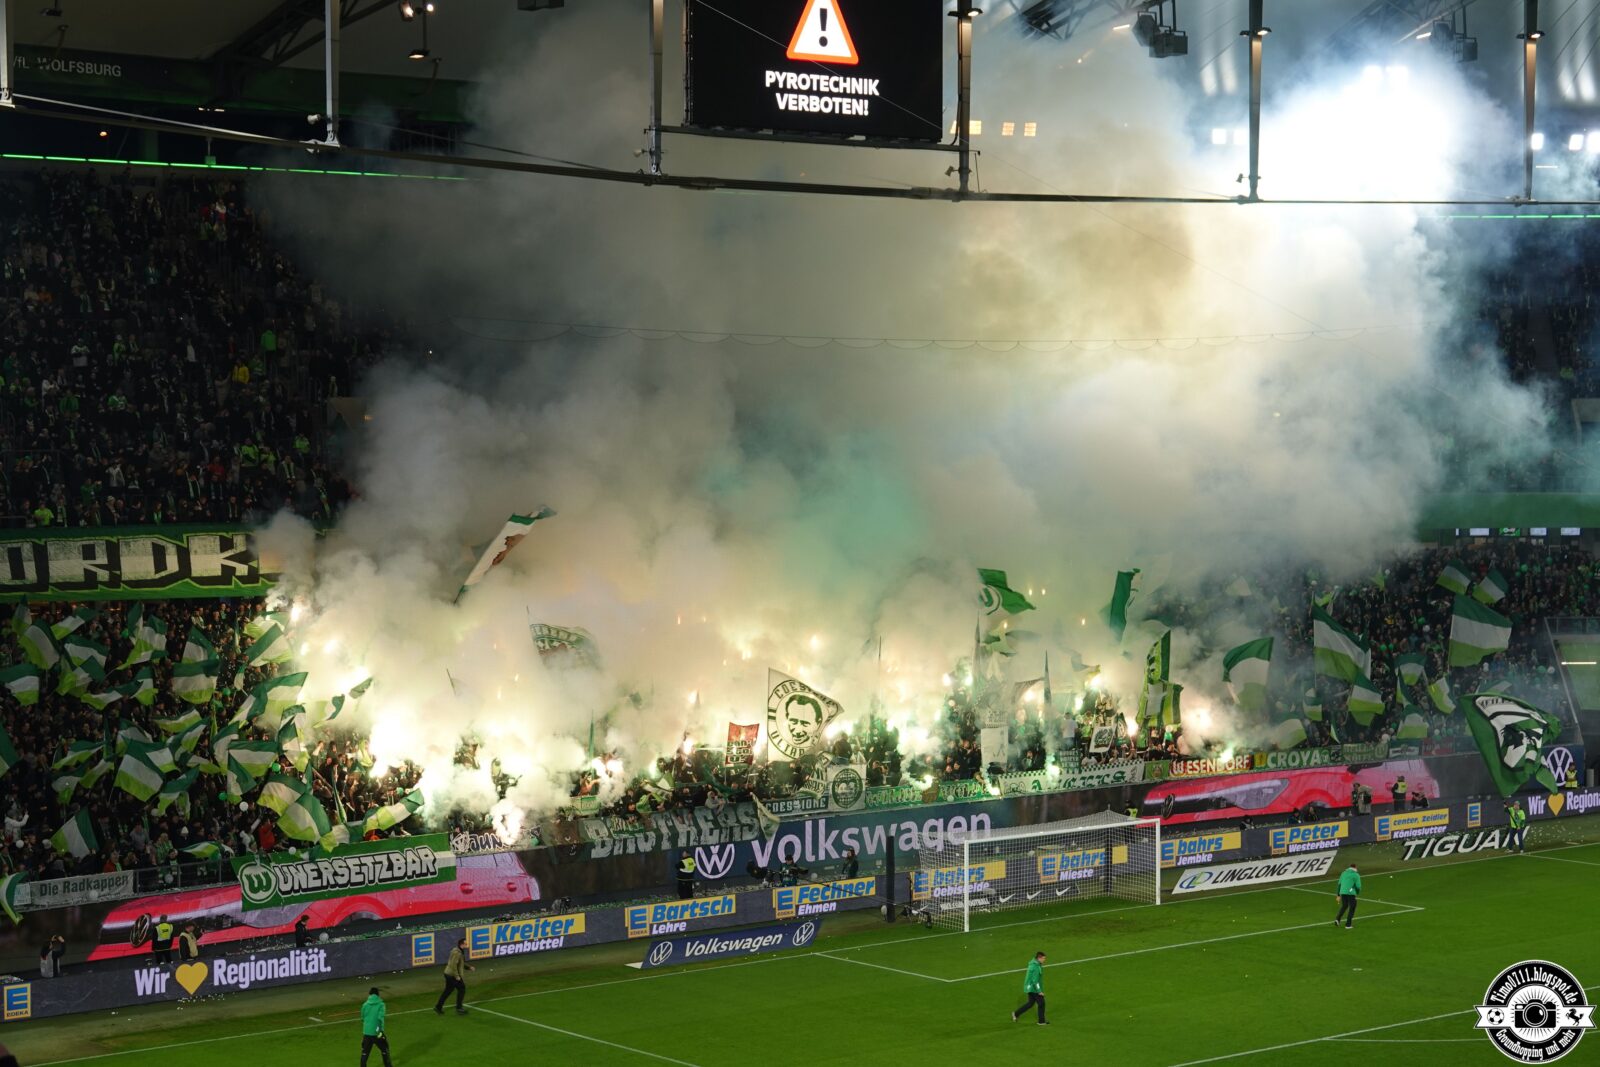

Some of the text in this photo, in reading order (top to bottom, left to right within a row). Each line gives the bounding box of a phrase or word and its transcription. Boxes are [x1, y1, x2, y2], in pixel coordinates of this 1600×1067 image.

[765, 70, 880, 96] PYROTECHNIK
[775, 92, 869, 116] VERBOTEN!
[1266, 750, 1322, 769] CROYA
[1528, 793, 1546, 815] Wir
[751, 811, 991, 868] Volkswagen
[1289, 825, 1339, 842] Peter
[1393, 826, 1447, 839] Königslutter
[1402, 826, 1530, 861] TIGUAN
[1178, 836, 1223, 855] bahrs
[1289, 839, 1340, 853] Westerbeck
[1177, 853, 1213, 866] Jembke
[1211, 856, 1333, 884] LINGLONG TIRE
[273, 847, 437, 896] UNERSETZBAR
[933, 866, 985, 887] bahrs
[1060, 868, 1094, 880] Mieste
[40, 874, 129, 897] Die Radkappen
[797, 880, 875, 904] Fechner
[933, 882, 990, 897] Oebiselde
[652, 896, 733, 922] Bartsch
[798, 901, 837, 916] Ehmen
[495, 918, 575, 944] Kreiter
[652, 921, 687, 935] Lehre
[495, 935, 564, 956] Isenbüttel
[684, 932, 783, 957] Volkswagen
[134, 948, 332, 996] Wir Regionalität.
